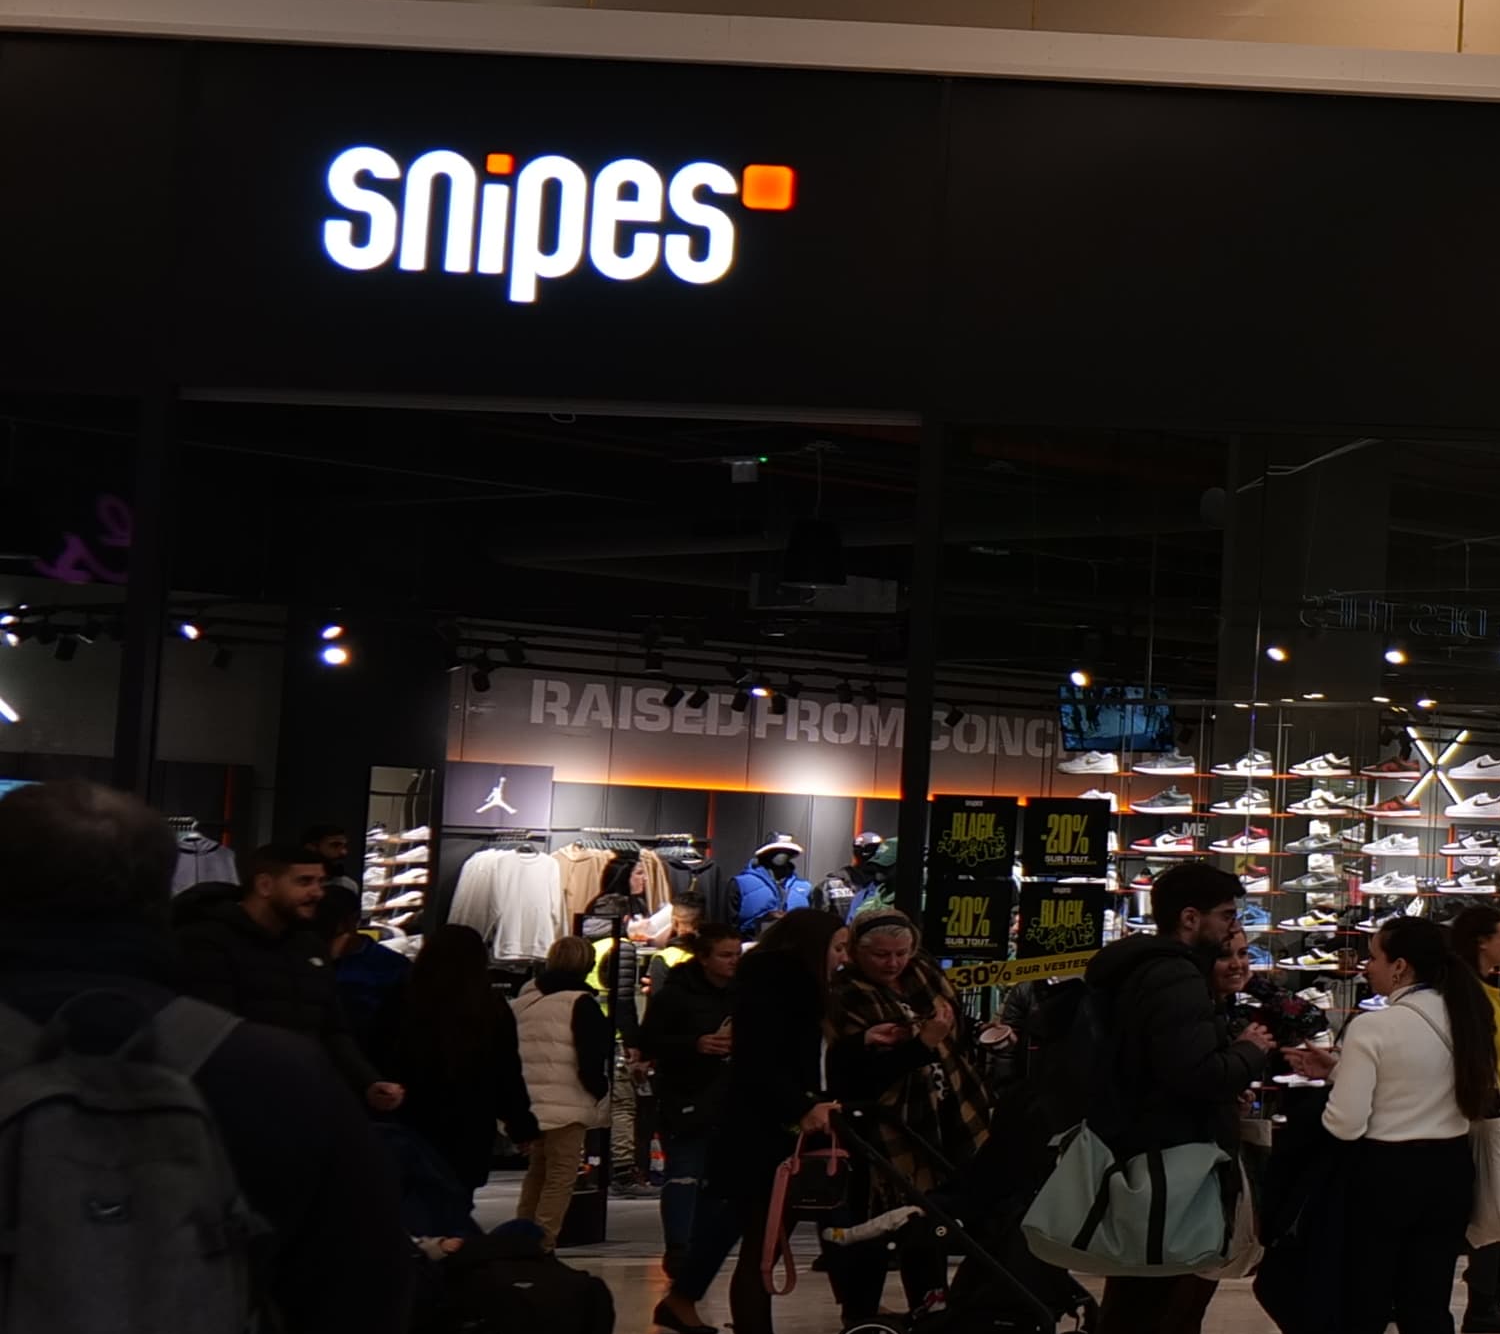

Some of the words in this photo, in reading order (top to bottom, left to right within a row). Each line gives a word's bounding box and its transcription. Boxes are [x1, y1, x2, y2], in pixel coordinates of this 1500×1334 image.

[323, 145, 739, 303] snipes
[530, 679, 748, 737] RAISED
[754, 698, 904, 749] FROM
[931, 708, 1074, 759] CONC
[952, 811, 997, 840] BLACK
[1041, 813, 1089, 855] -20%
[1044, 854, 1062, 864] SUR
[942, 895, 990, 937] -20%
[1040, 899, 1083, 929] BLACK
[944, 937, 965, 946] SUR
[950, 963, 1012, 988] -30%
[1015, 963, 1040, 976] SUR
[1044, 958, 1089, 972] VESTES
